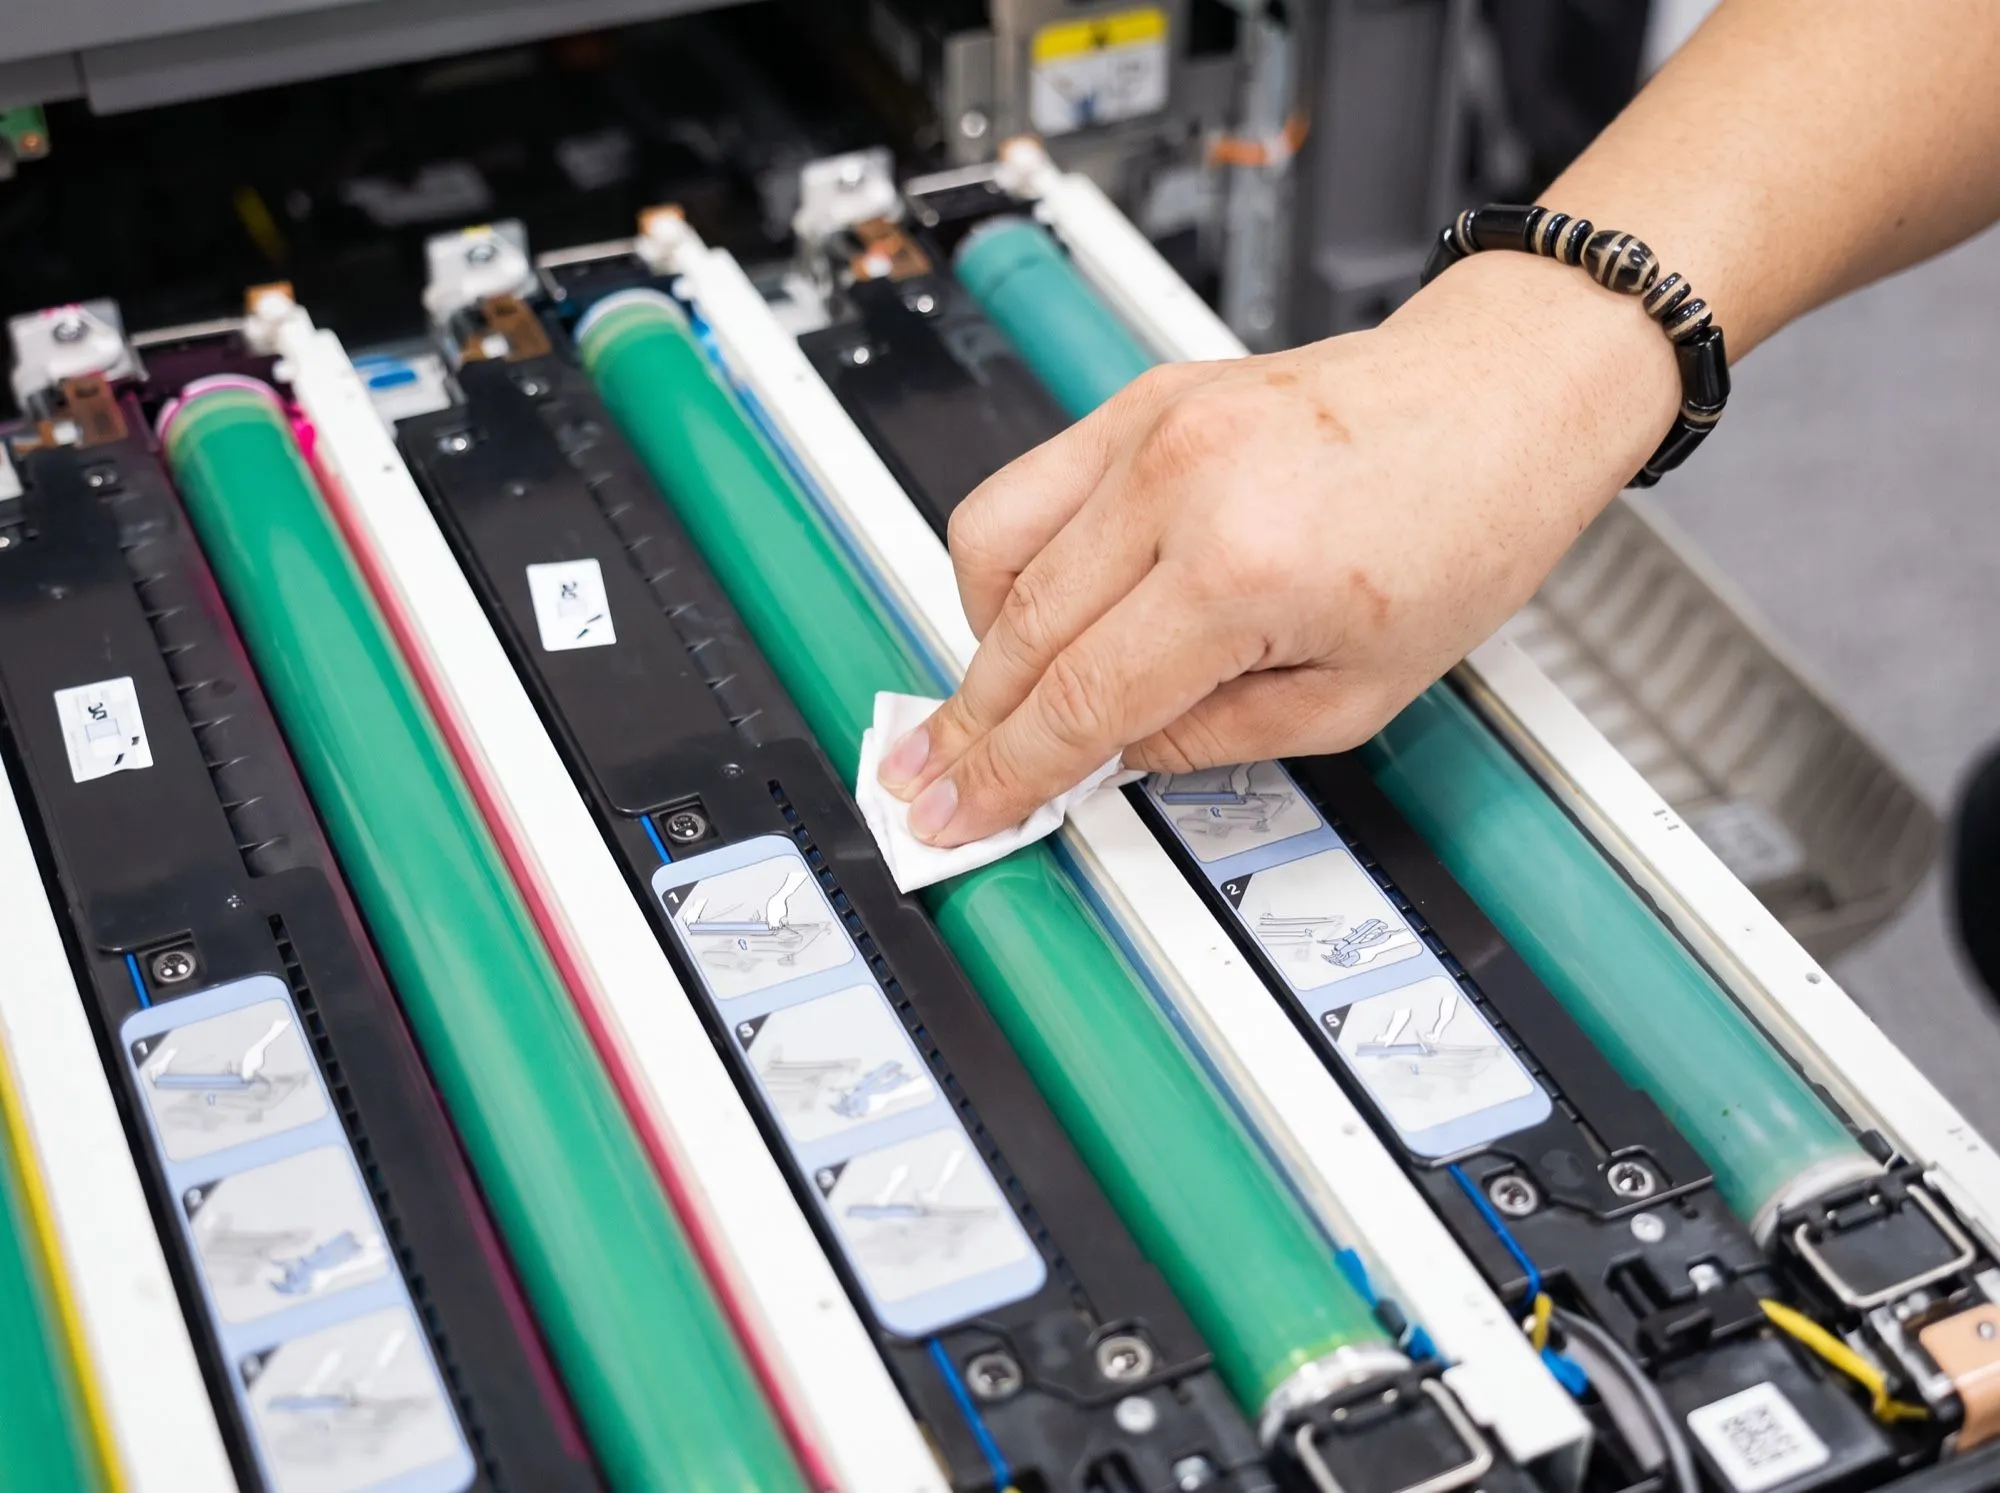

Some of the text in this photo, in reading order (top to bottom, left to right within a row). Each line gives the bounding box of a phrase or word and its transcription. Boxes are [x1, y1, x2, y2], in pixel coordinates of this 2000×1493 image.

[1226, 883, 1241, 896] 2
[668, 891, 680, 904] 1
[137, 1040, 149, 1056] 1
